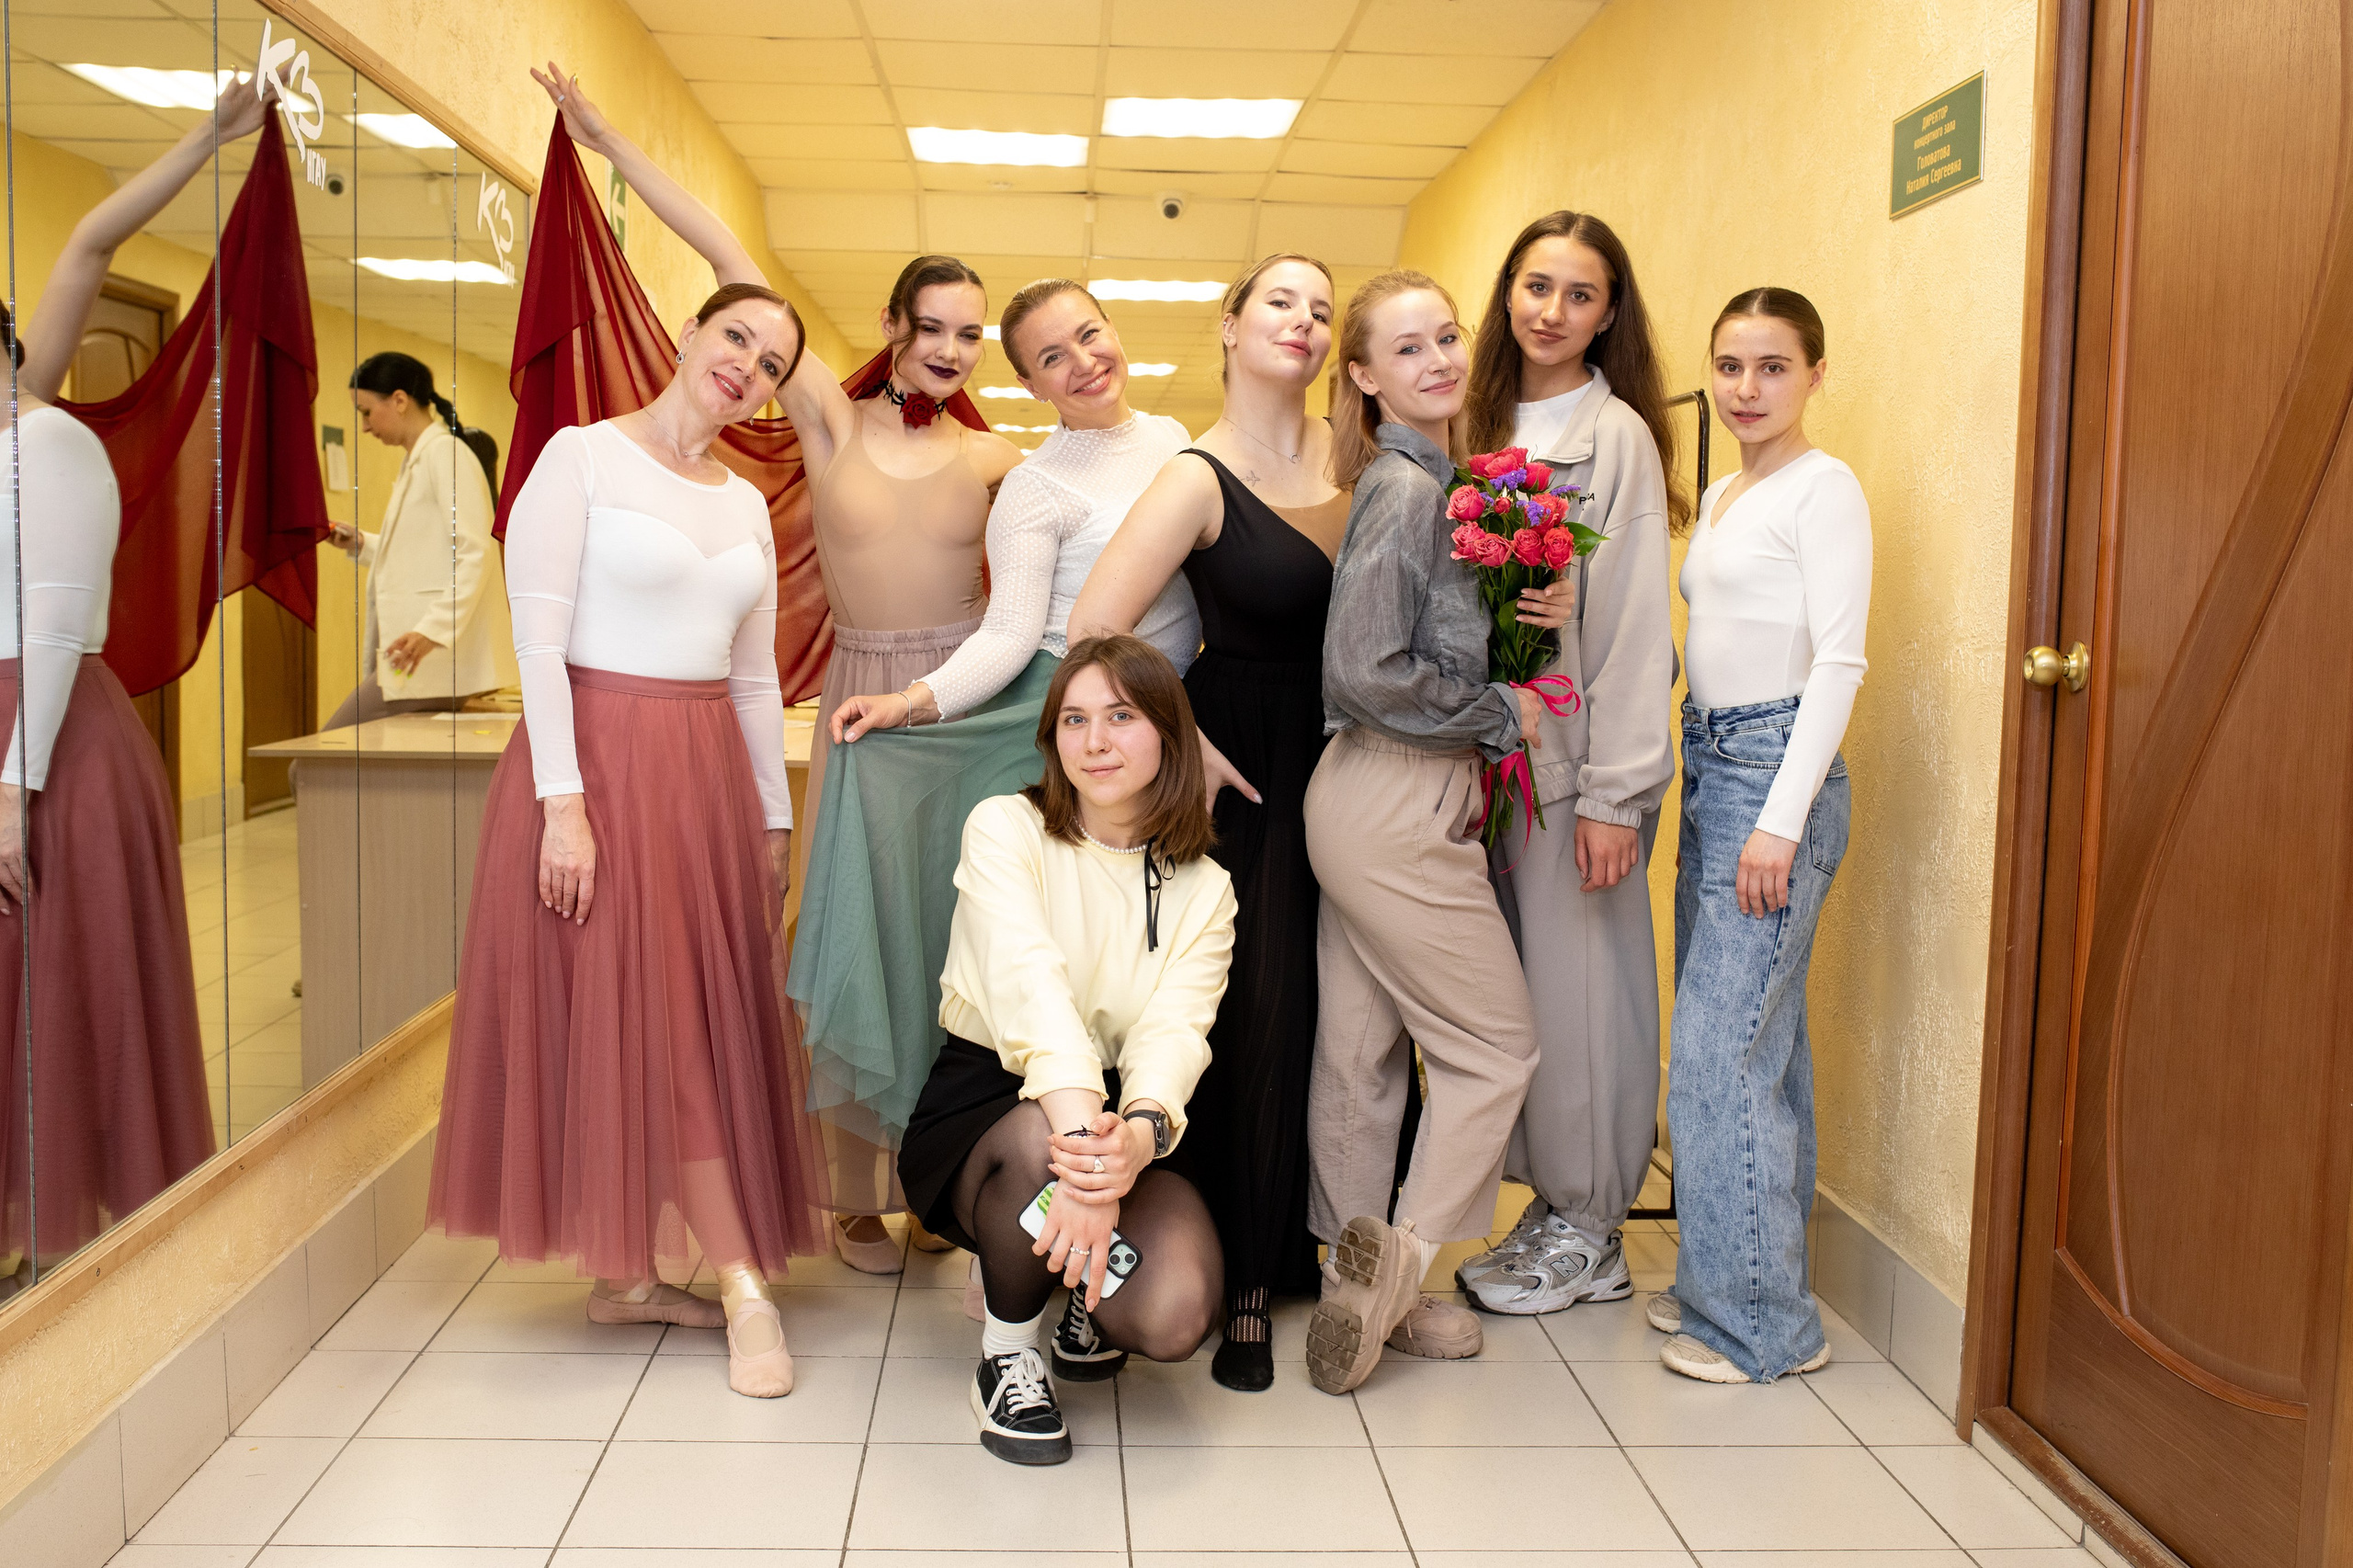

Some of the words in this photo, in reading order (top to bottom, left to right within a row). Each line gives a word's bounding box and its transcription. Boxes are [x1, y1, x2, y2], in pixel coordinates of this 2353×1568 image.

[1922, 105, 1949, 131] ДИРЕКТОР
[1914, 126, 1943, 150] концертного
[1944, 119, 1956, 135] зала
[306, 147, 326, 191] НГАУ
[1916, 144, 1950, 172] Головатова
[1905, 174, 1929, 196] Наталия
[1930, 158, 1961, 184] Сергеевна
[1549, 1254, 1580, 1278] N
